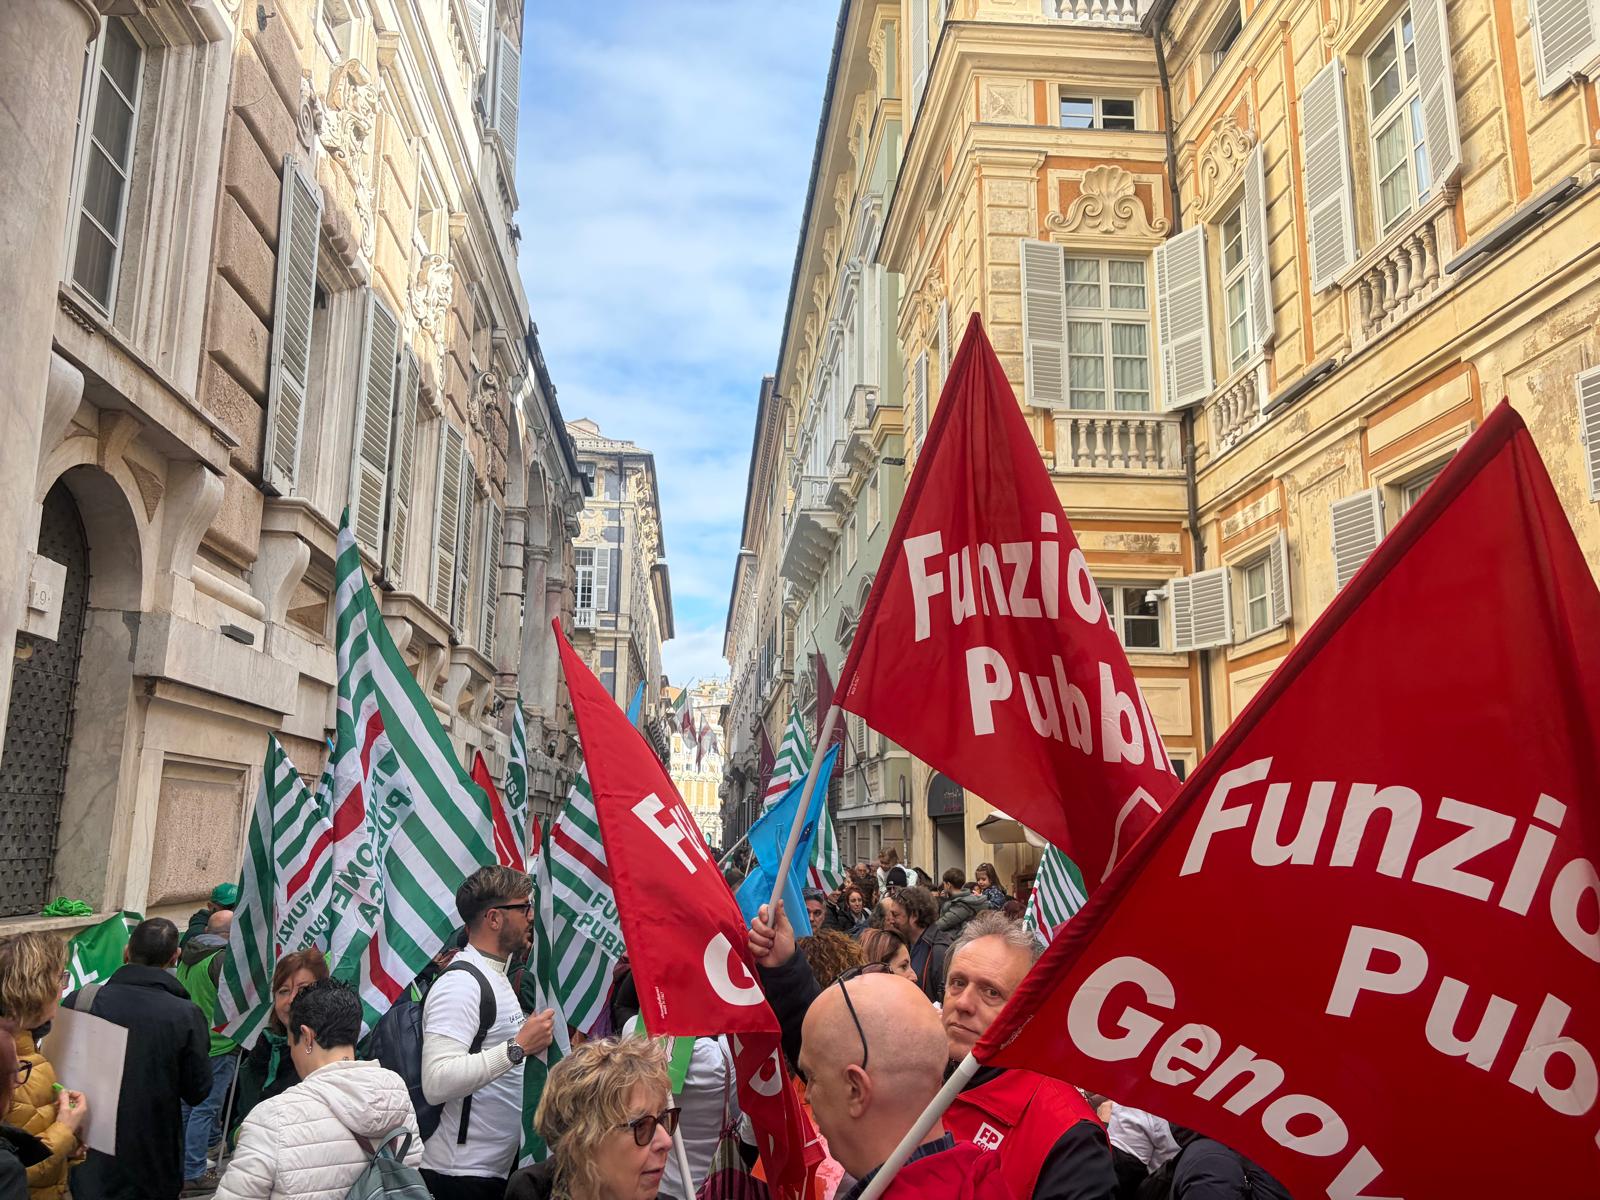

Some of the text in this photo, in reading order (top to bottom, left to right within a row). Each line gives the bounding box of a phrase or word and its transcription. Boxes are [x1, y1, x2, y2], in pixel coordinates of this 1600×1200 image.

[39, 590, 47, 606] 9
[903, 512, 1117, 643] Funzio
[1325, 925, 1600, 1150] Pub
[979, 1127, 999, 1144] FP
